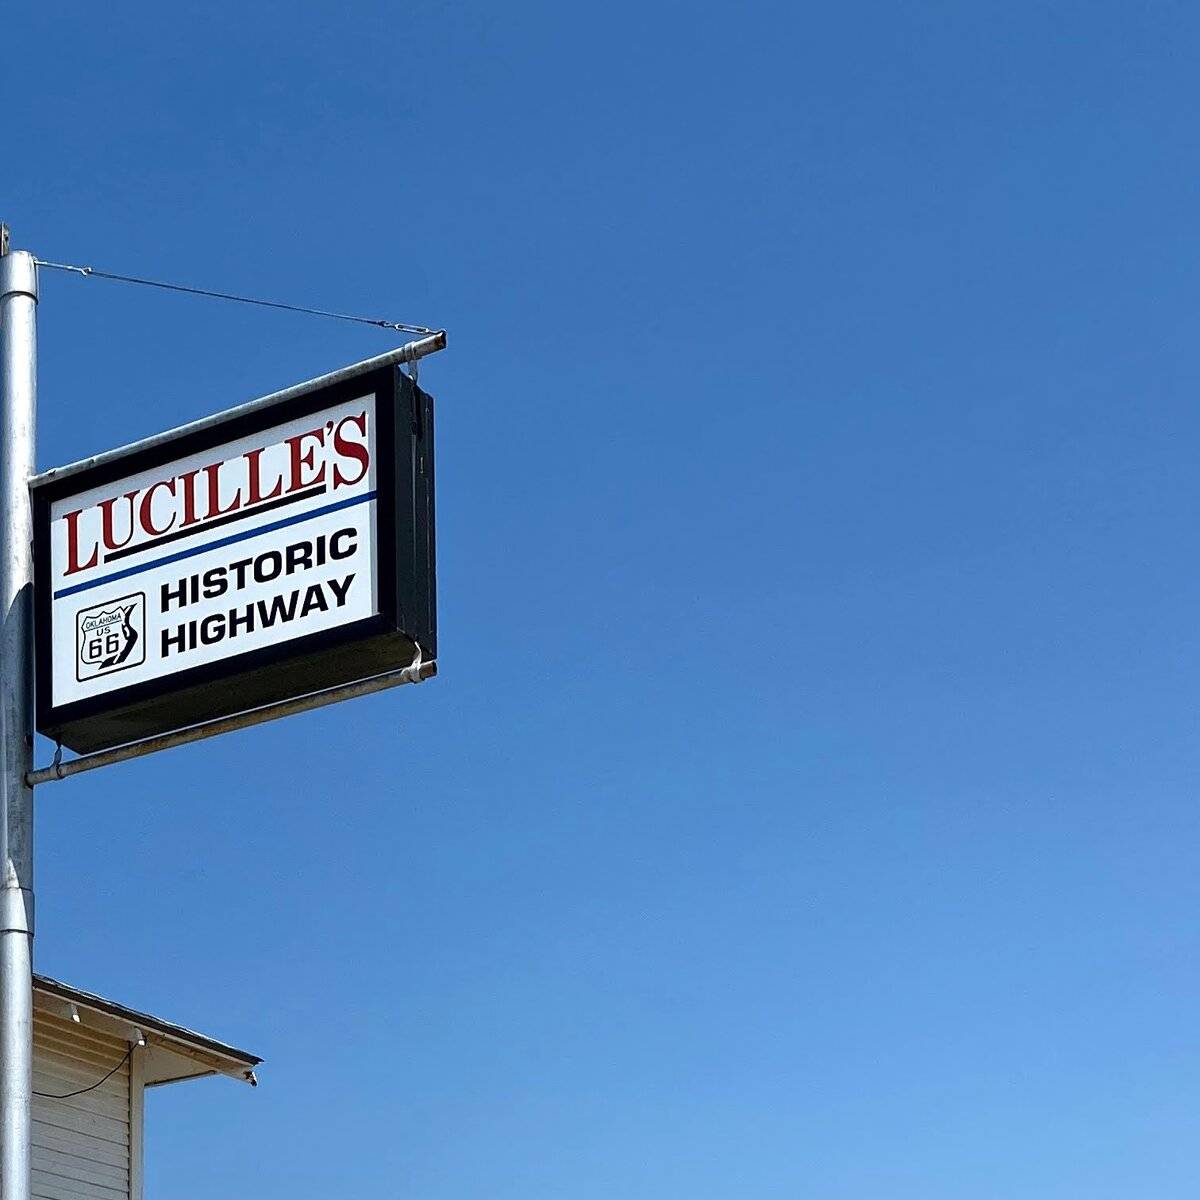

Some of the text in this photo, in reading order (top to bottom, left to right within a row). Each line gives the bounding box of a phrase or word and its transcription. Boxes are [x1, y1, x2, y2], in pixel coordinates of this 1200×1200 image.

[62, 411, 370, 577] LUCILLE'S
[161, 527, 358, 613] HISTORIC
[85, 612, 122, 630] OKLAHOMA
[96, 626, 111, 637] US
[161, 573, 356, 658] HIGHWAY
[89, 632, 119, 659] 66
